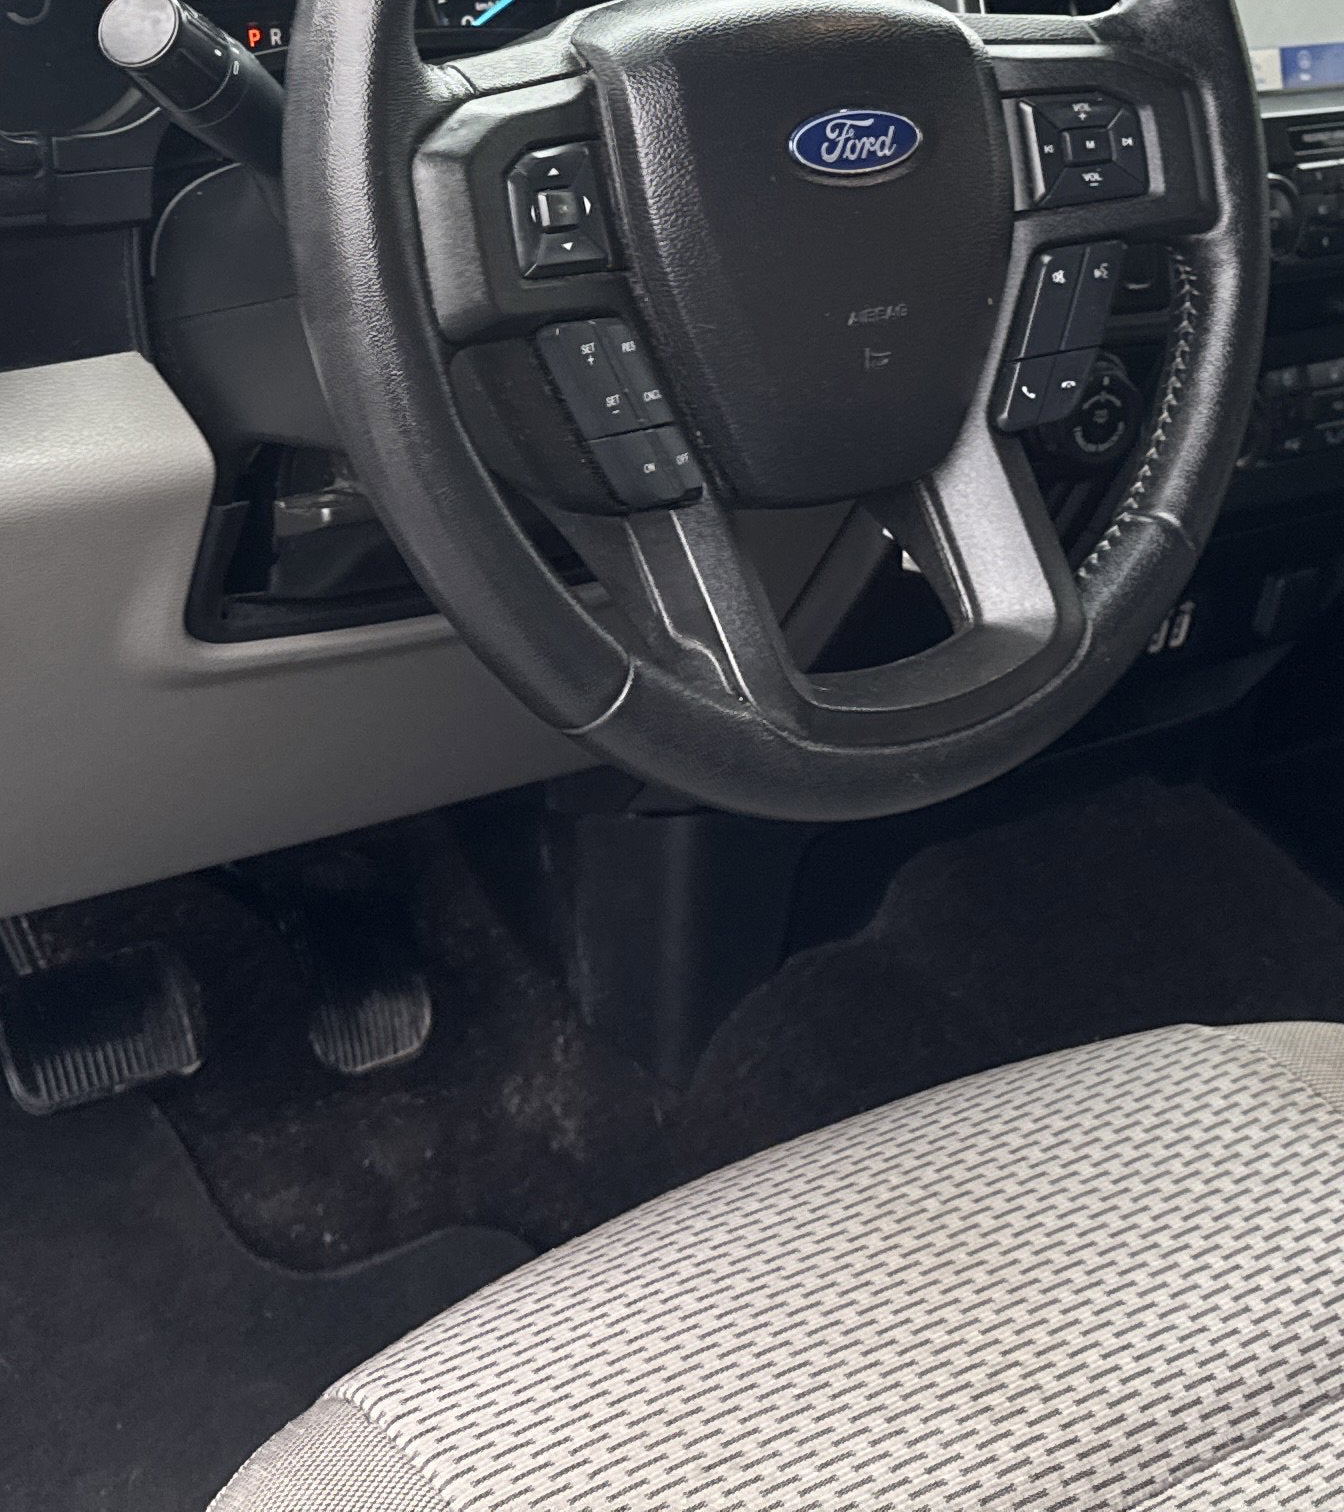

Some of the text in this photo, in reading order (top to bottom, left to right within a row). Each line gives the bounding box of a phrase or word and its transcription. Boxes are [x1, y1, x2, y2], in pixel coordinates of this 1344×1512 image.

[248, 28, 282, 48] P R
[1072, 103, 1092, 113] VOL
[821, 118, 896, 163] Ford
[1086, 140, 1096, 149] M
[1082, 172, 1102, 182] VOL
[580, 342, 595, 354] SET
[621, 341, 636, 353] RES
[606, 394, 620, 407] SET
[676, 452, 689, 465] OFF
[644, 463, 656, 474] ON
